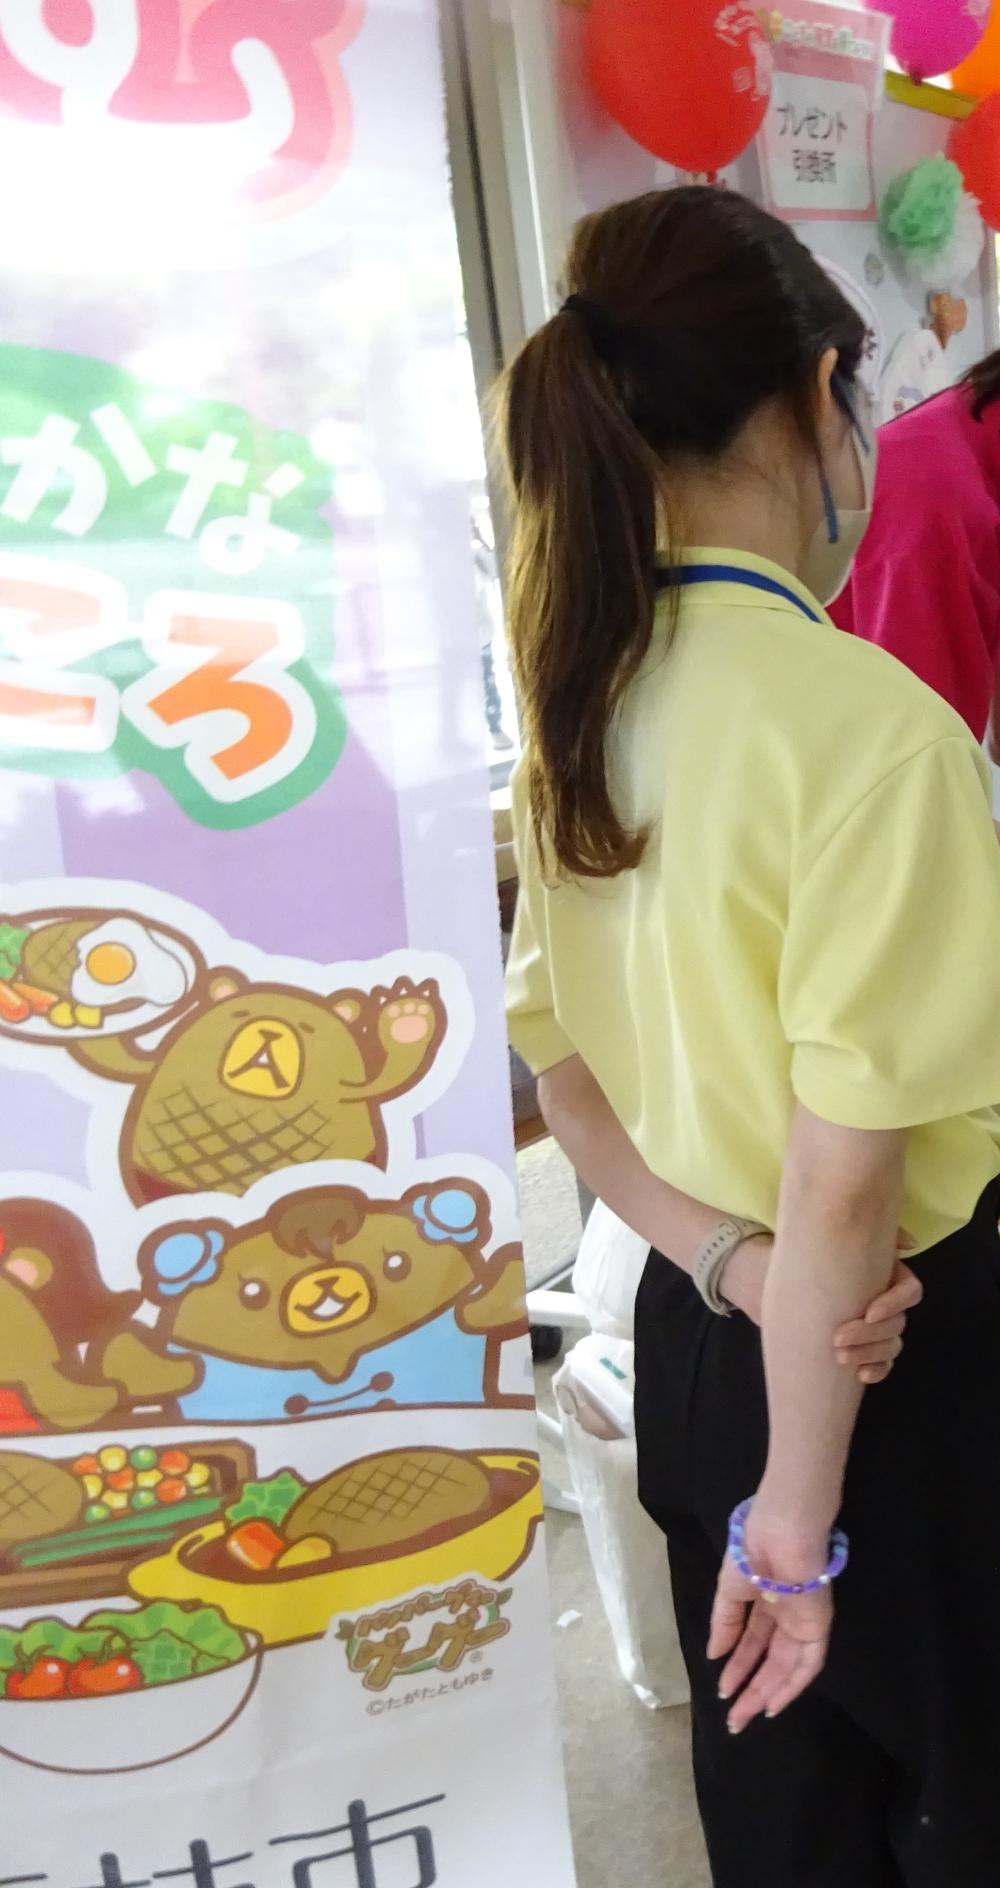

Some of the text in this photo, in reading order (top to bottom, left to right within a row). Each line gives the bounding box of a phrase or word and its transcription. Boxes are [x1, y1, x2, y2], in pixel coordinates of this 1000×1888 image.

[776, 102, 848, 143] プレゼント
[2, 402, 305, 573] かな
